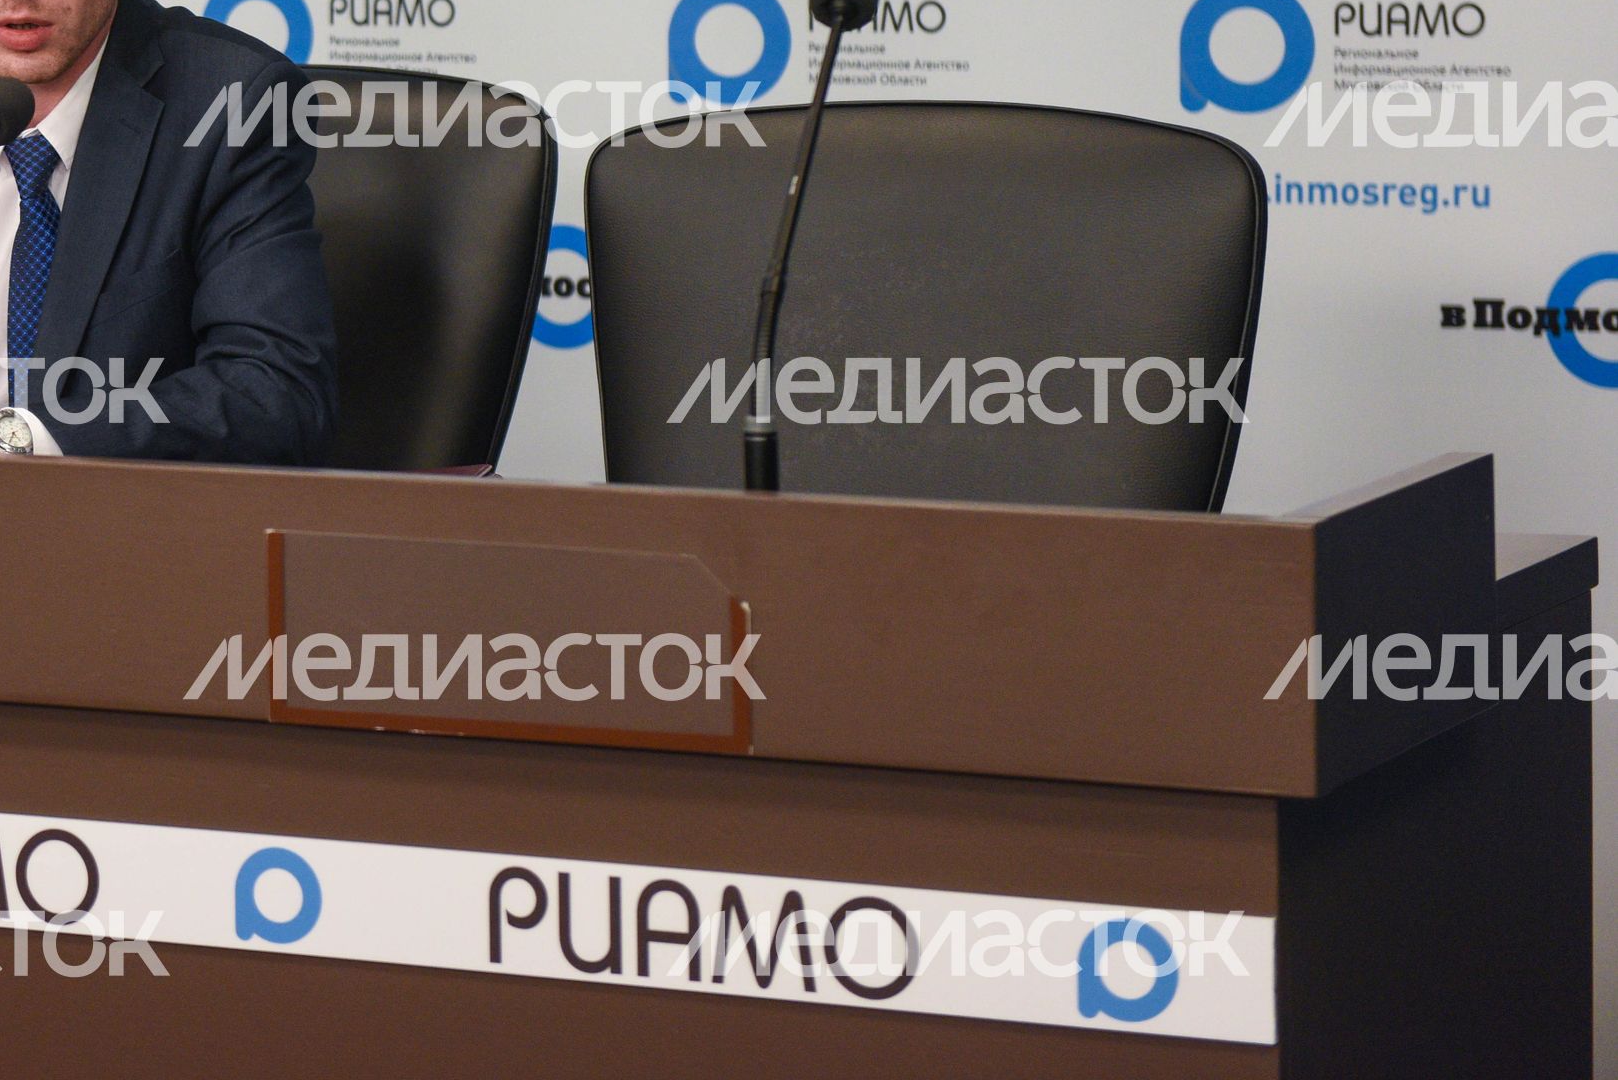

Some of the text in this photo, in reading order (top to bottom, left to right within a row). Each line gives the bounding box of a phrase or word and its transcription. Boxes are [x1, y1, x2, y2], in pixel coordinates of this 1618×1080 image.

[1334, 2, 1485, 37] РИАМО
[1440, 304, 1466, 328] в
[488, 866, 921, 1002] РИАМО
